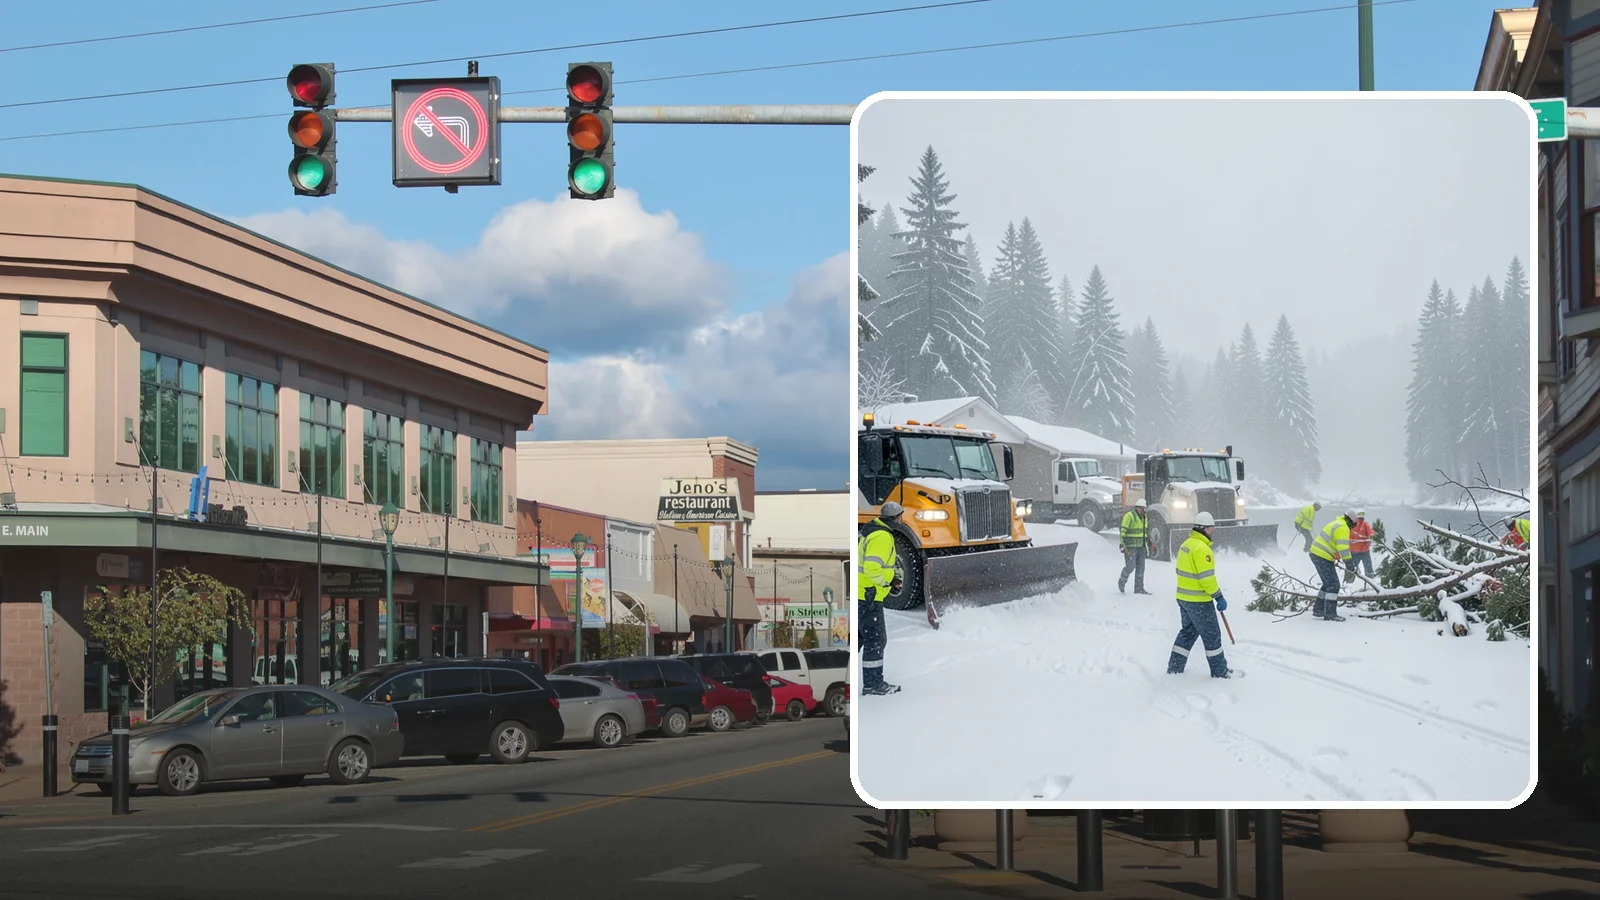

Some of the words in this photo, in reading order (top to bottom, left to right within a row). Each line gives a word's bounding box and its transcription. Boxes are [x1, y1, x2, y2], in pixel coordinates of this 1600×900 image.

[670, 480, 727, 494] Jeno's
[665, 496, 731, 509] restaurant
[658, 509, 682, 519] Italian
[686, 509, 715, 519] American
[715, 509, 738, 519] Cuisine
[2, 525, 13, 536] E.
[15, 525, 49, 537] MAIN
[797, 607, 828, 617] Street
